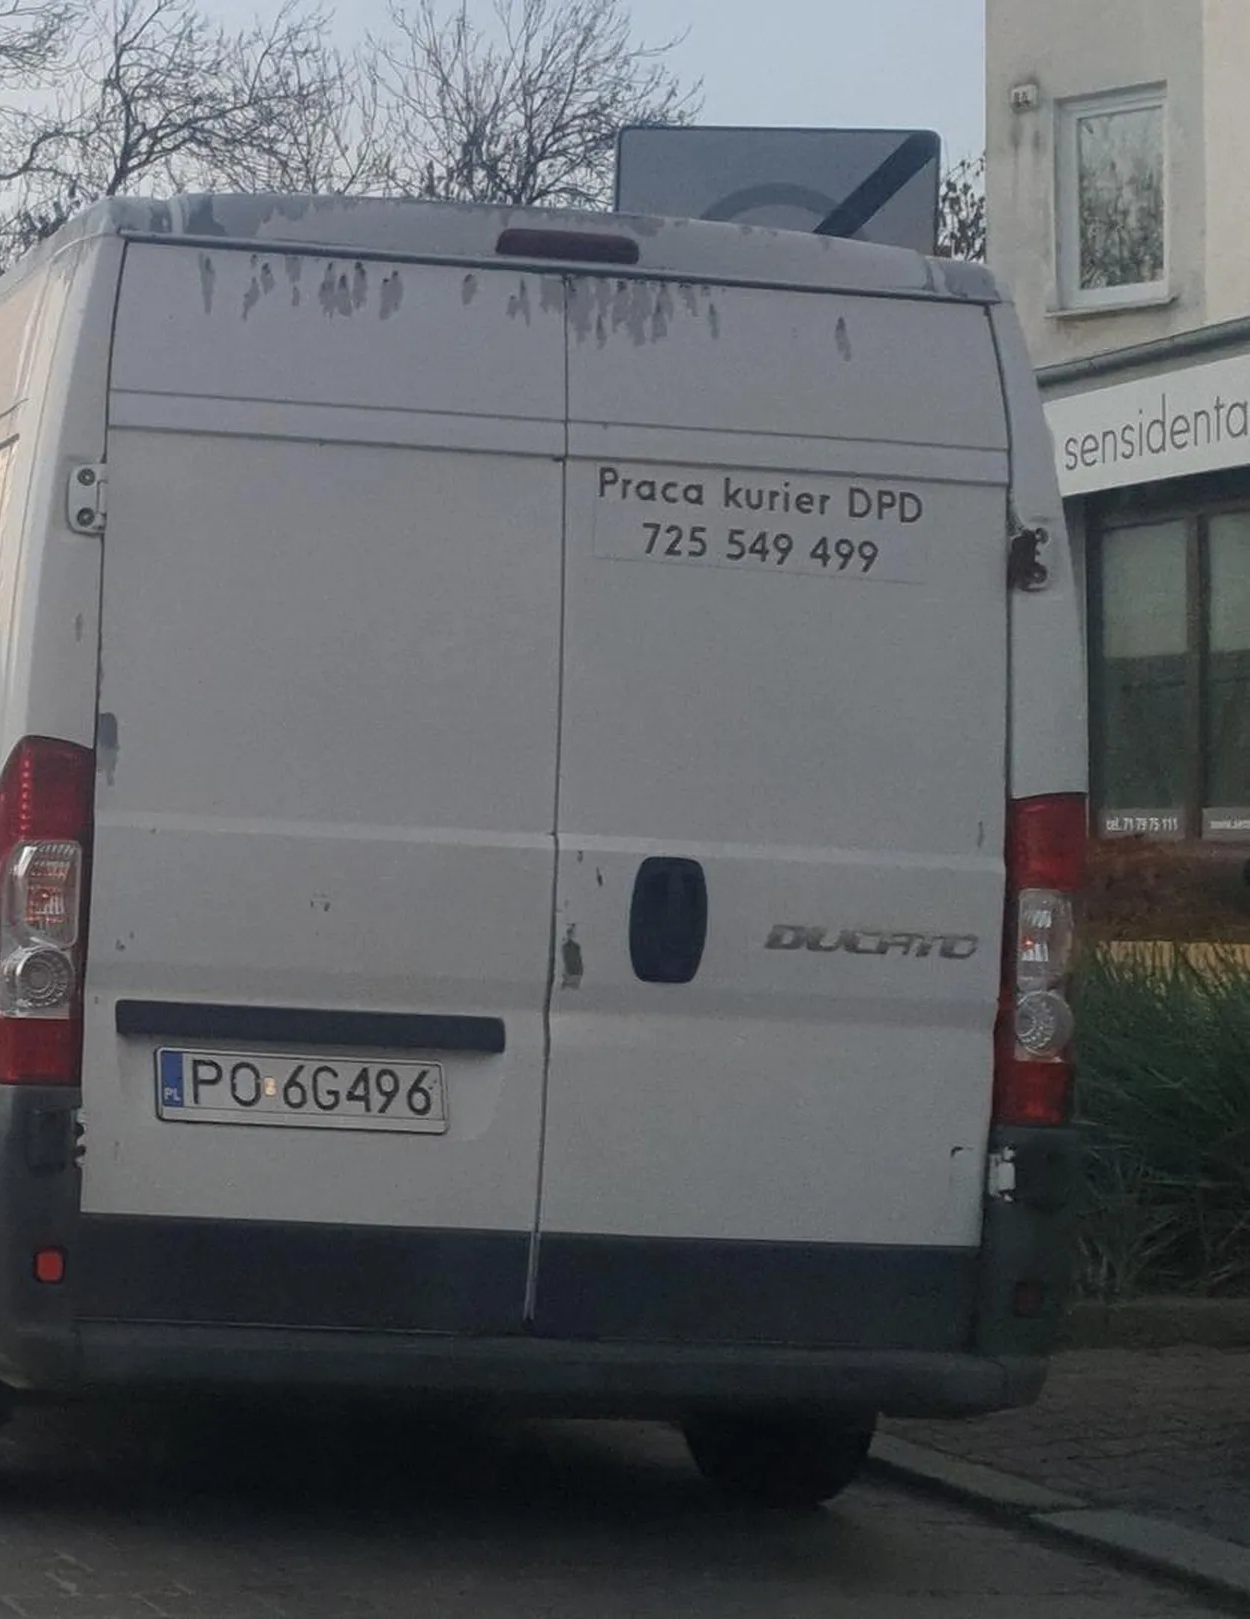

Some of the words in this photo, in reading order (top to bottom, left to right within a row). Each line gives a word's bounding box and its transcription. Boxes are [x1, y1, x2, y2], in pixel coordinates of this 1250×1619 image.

[1064, 393, 1249, 471] sensidenta
[599, 467, 704, 505] Praca
[723, 477, 830, 516] kurier
[848, 486, 923, 523] DPD
[642, 522, 707, 557] 725
[726, 529, 794, 565] 549
[810, 537, 879, 573] 499
[764, 924, 979, 960] DUCATO
[191, 1059, 262, 1107] PO
[283, 1065, 432, 1116] 6G496
